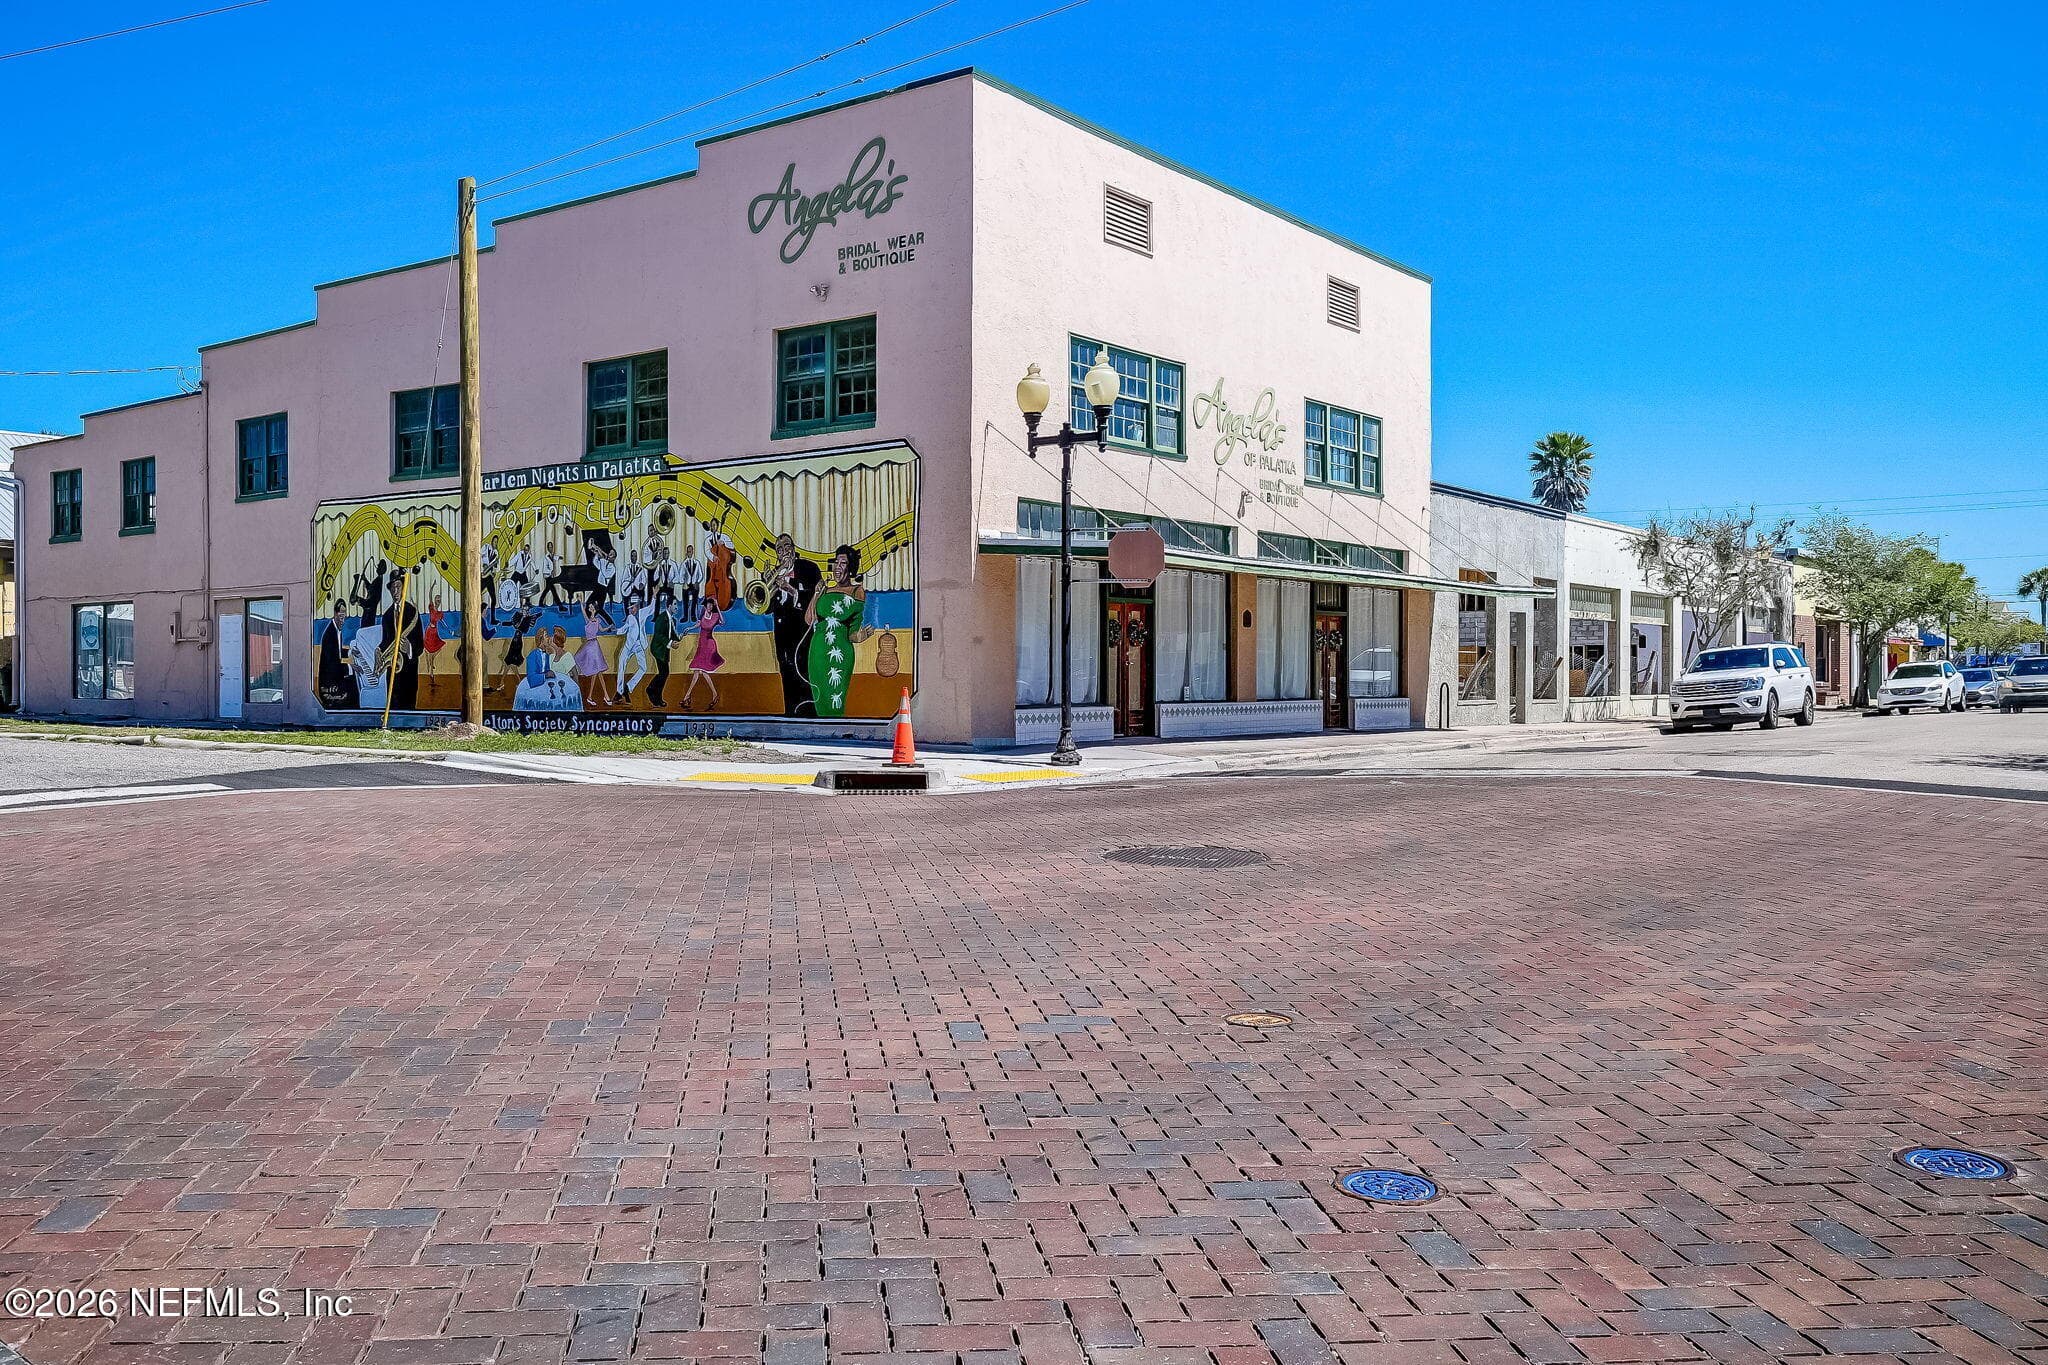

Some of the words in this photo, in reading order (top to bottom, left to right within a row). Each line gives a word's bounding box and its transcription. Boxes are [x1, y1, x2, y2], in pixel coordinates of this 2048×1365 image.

[748, 136, 909, 264] Angela's
[837, 239, 880, 261] BRIDAL
[887, 231, 925, 249] WEAR
[838, 261, 847, 275] &
[852, 248, 916, 272] BOUTIQUE
[1193, 376, 1286, 465] Angela's
[1243, 452, 1256, 467] OF
[1259, 454, 1297, 475] PALATKA
[480, 473, 527, 492] arlem
[531, 466, 580, 488] Nights
[584, 464, 597, 479] in
[1259, 479, 1282, 492] BRIDAL
[493, 504, 574, 529] COTTON
[586, 498, 642, 521] CLUB
[1266, 492, 1299, 508] BOUTIQUE
[525, 715, 567, 730] Society
